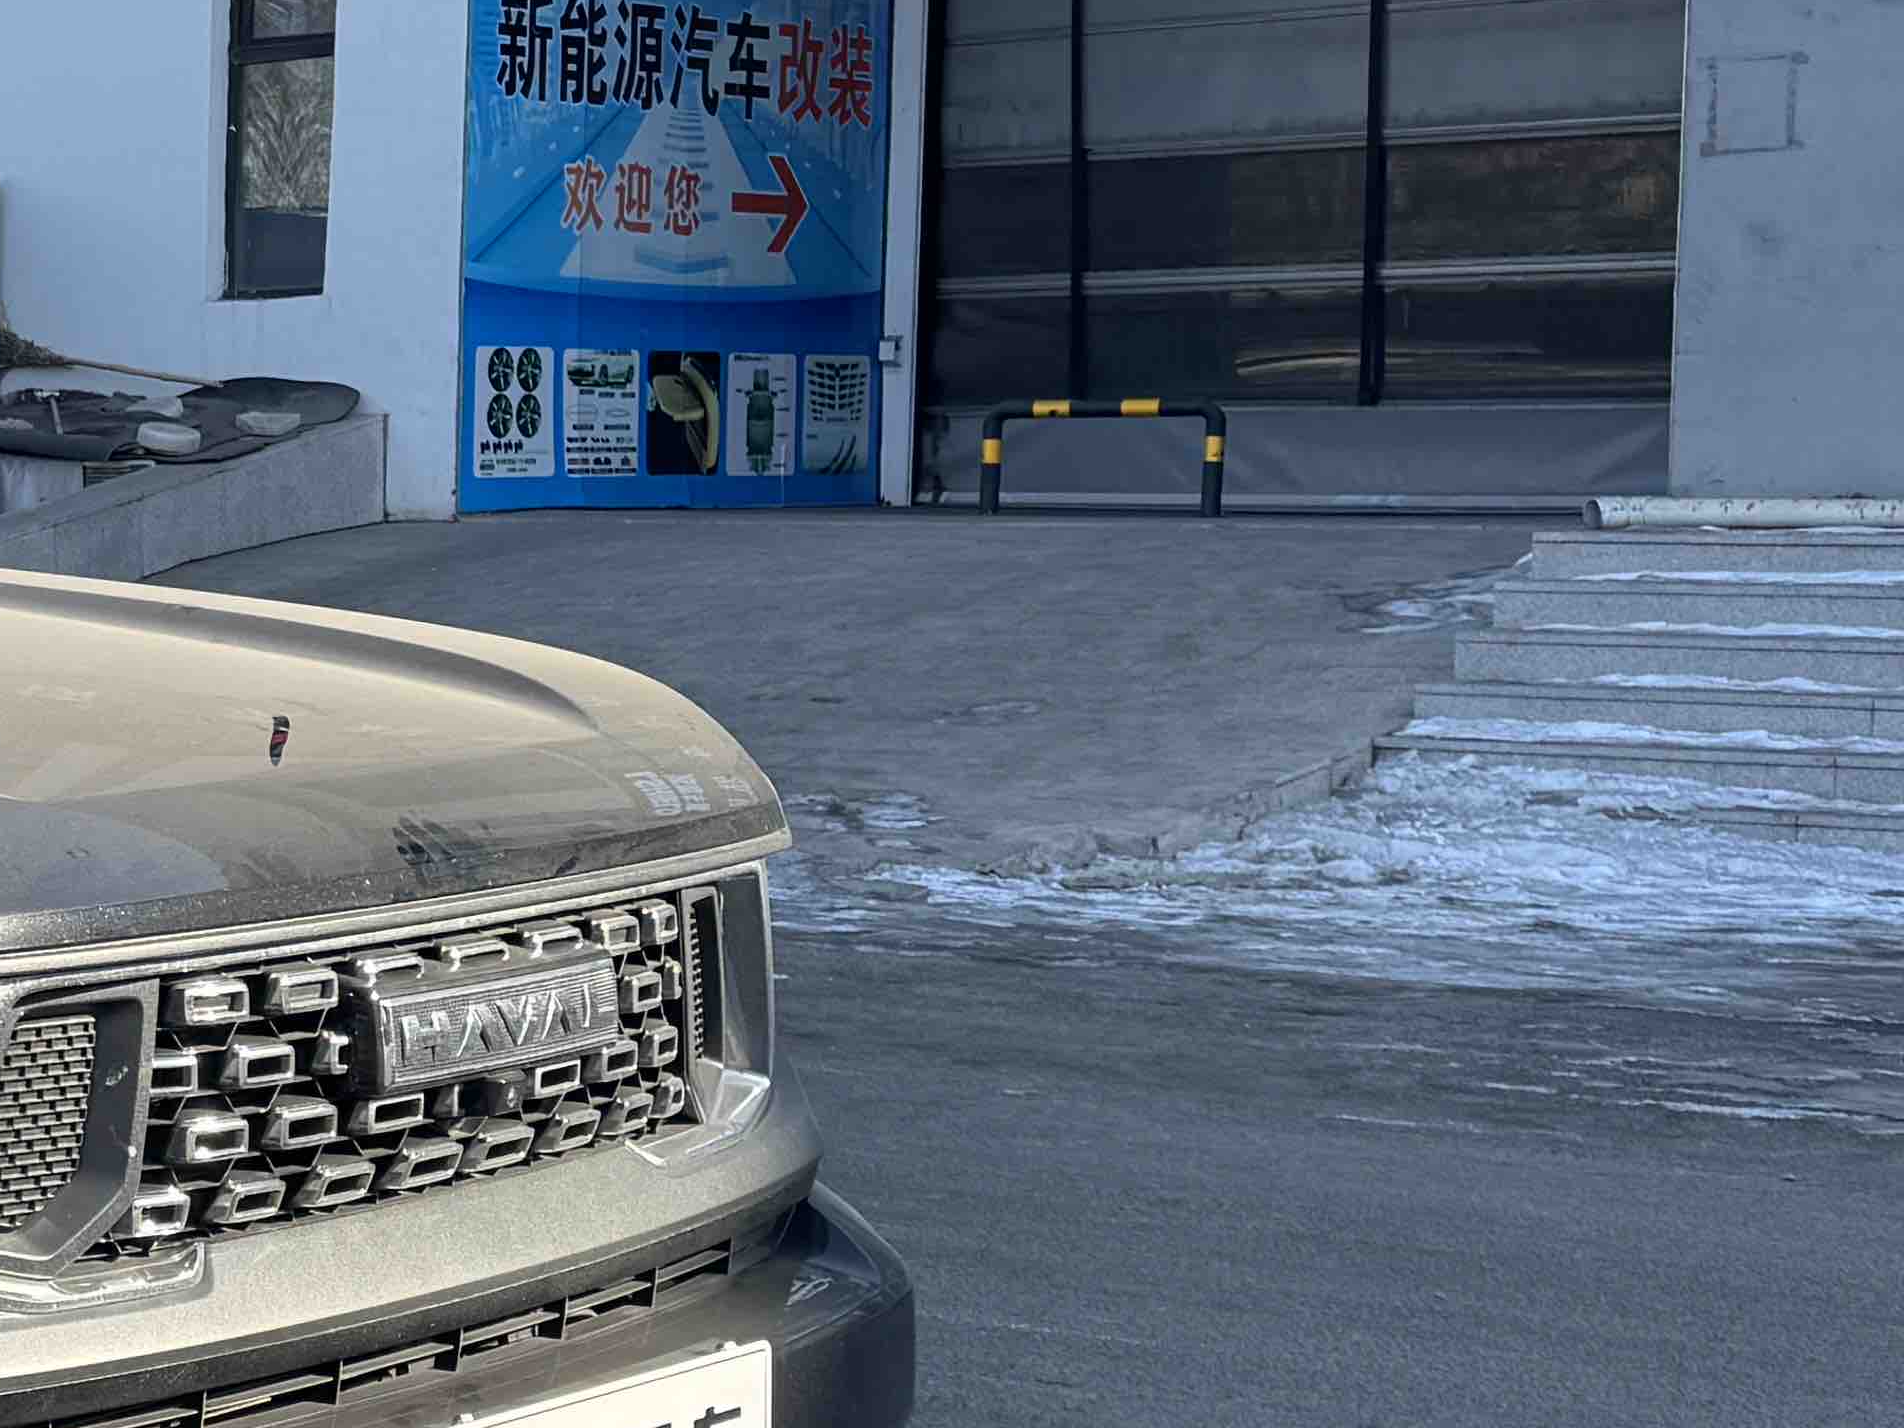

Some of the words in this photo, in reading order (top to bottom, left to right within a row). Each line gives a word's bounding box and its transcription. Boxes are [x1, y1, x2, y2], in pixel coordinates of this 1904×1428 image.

[561, 157, 702, 237] 欢迎您
[400, 983, 613, 1068] HAVAL
